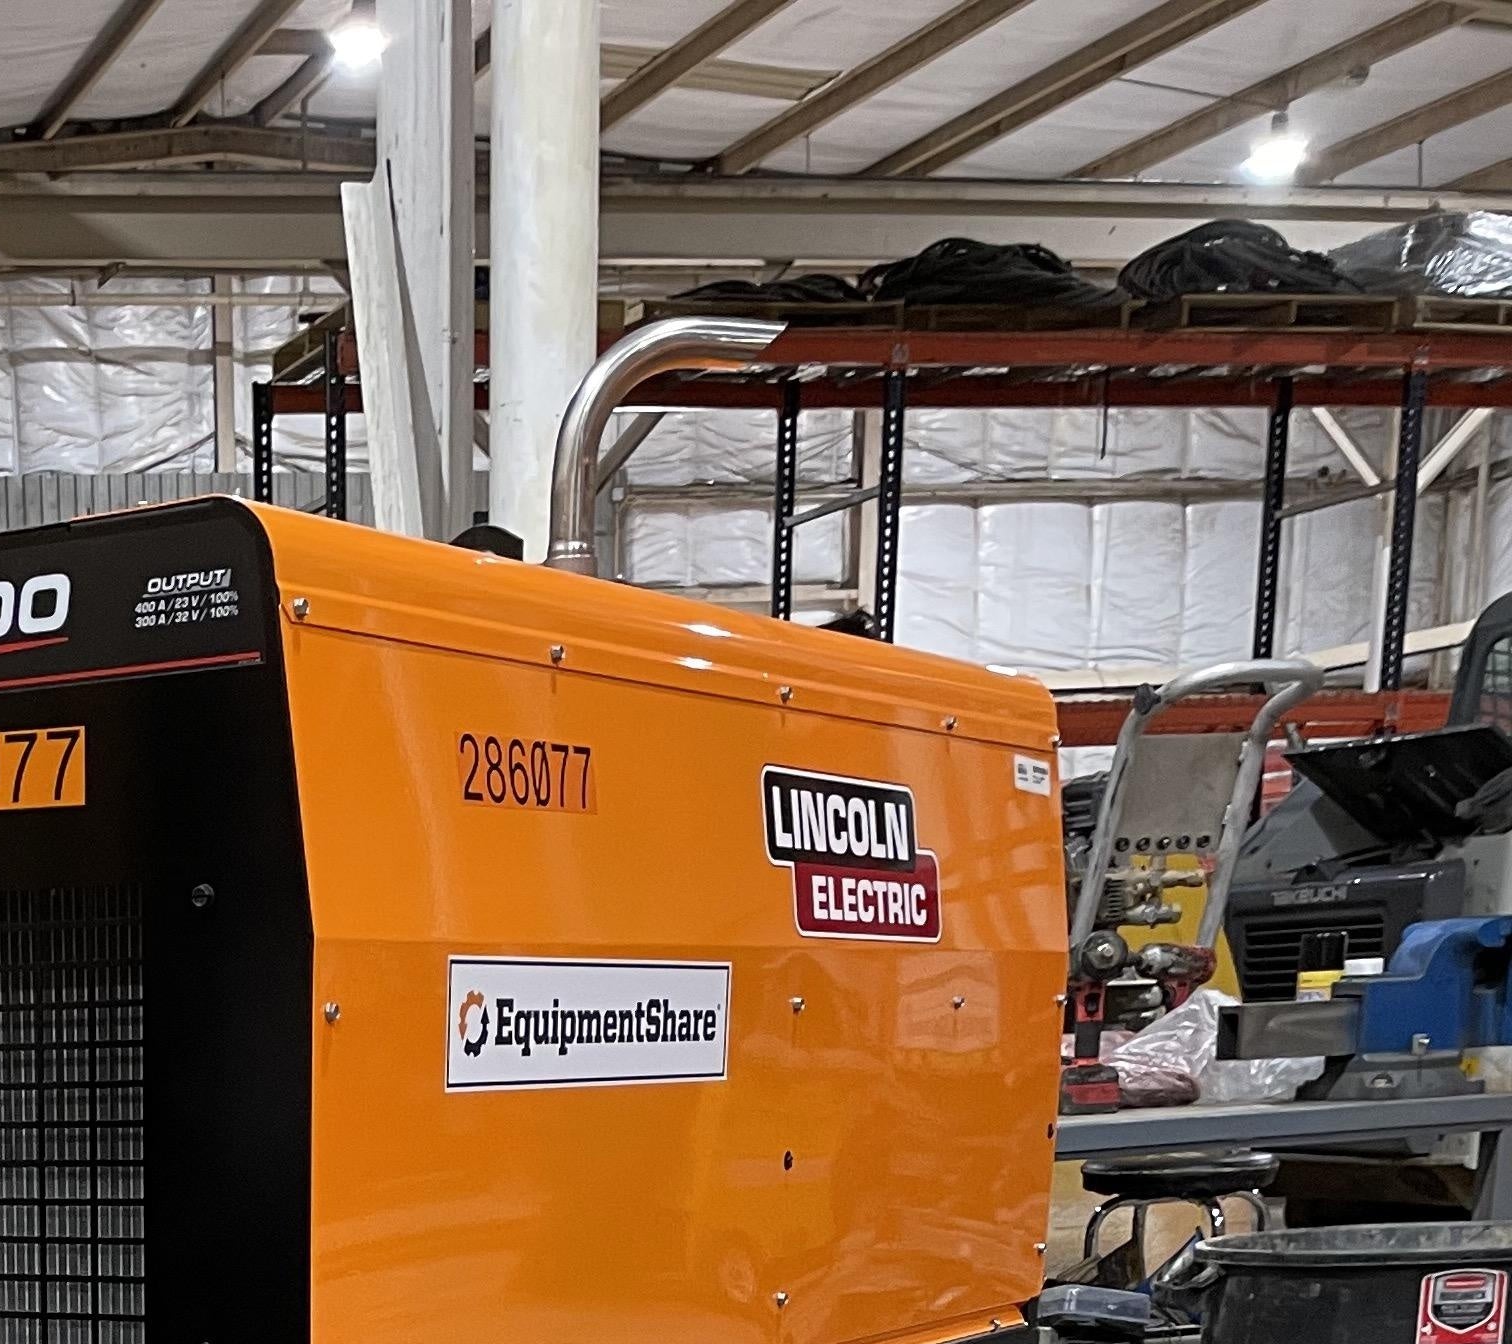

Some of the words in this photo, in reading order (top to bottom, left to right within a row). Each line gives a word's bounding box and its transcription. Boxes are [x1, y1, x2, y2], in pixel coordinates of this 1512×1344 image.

[147, 569, 226, 593] OUTPUT
[210, 591, 239, 603] 100%
[210, 605, 239, 618] 100%
[460, 733, 591, 809] 286077
[771, 785, 910, 861] LINCOLN
[811, 875, 927, 926] ELECTRIC
[494, 997, 717, 1057] EquipmentShare
